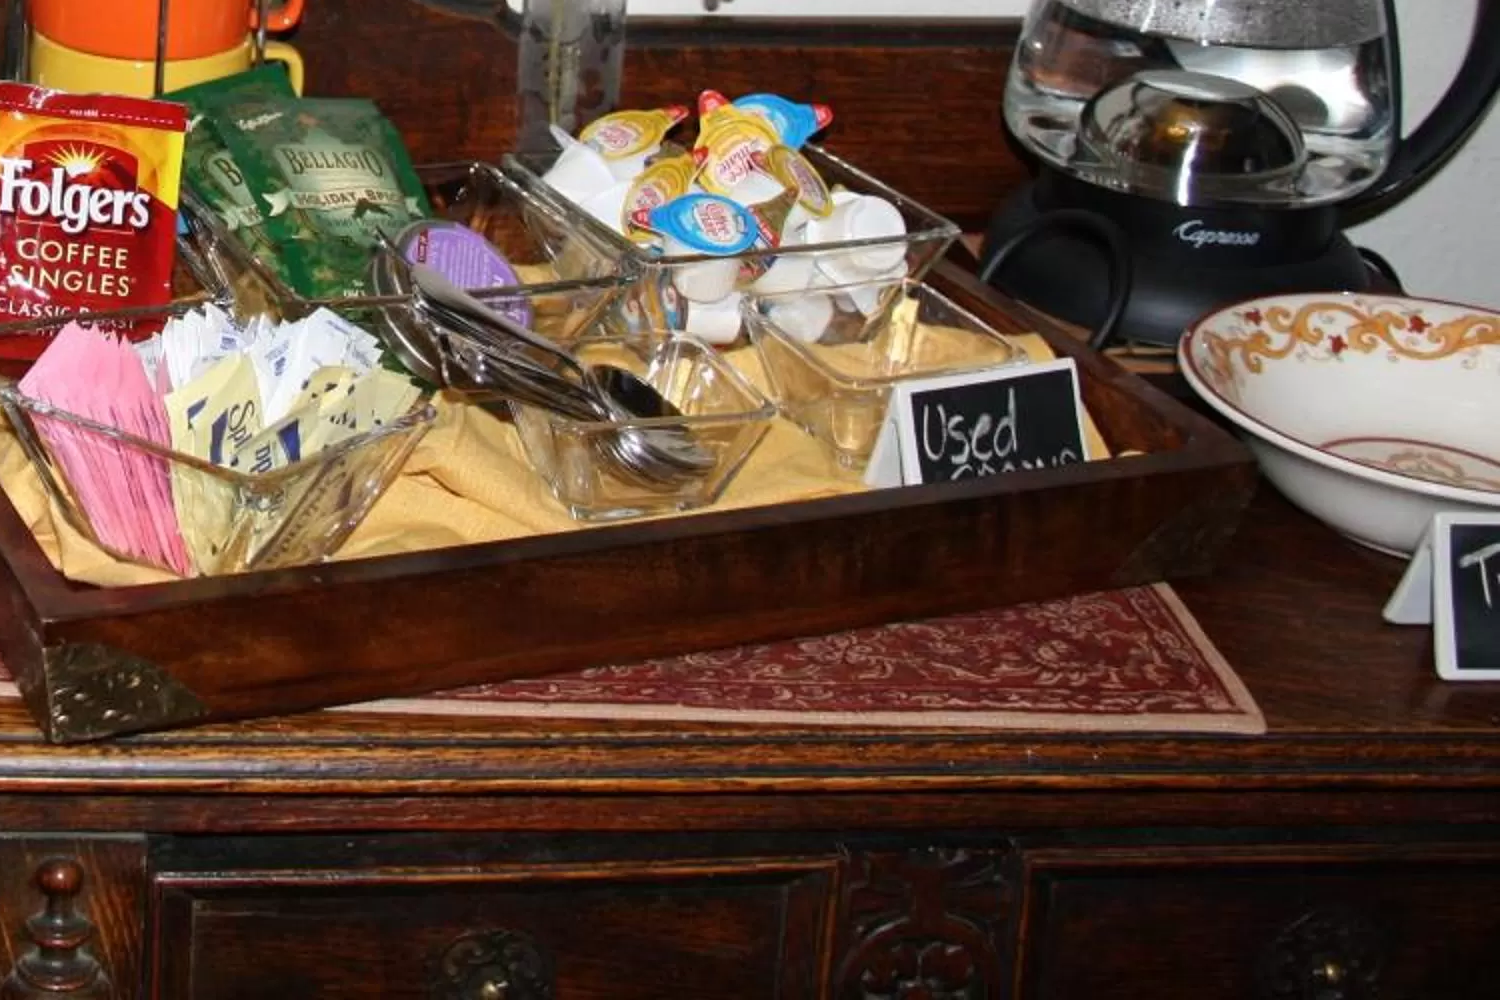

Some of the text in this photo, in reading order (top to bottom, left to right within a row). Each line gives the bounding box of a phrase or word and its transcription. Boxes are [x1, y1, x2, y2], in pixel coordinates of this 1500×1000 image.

[280, 147, 384, 178] BELLAGIO
[17, 238, 129, 270] COFFEE
[10, 264, 130, 297] SINGLES
[922, 386, 1018, 465] Used
